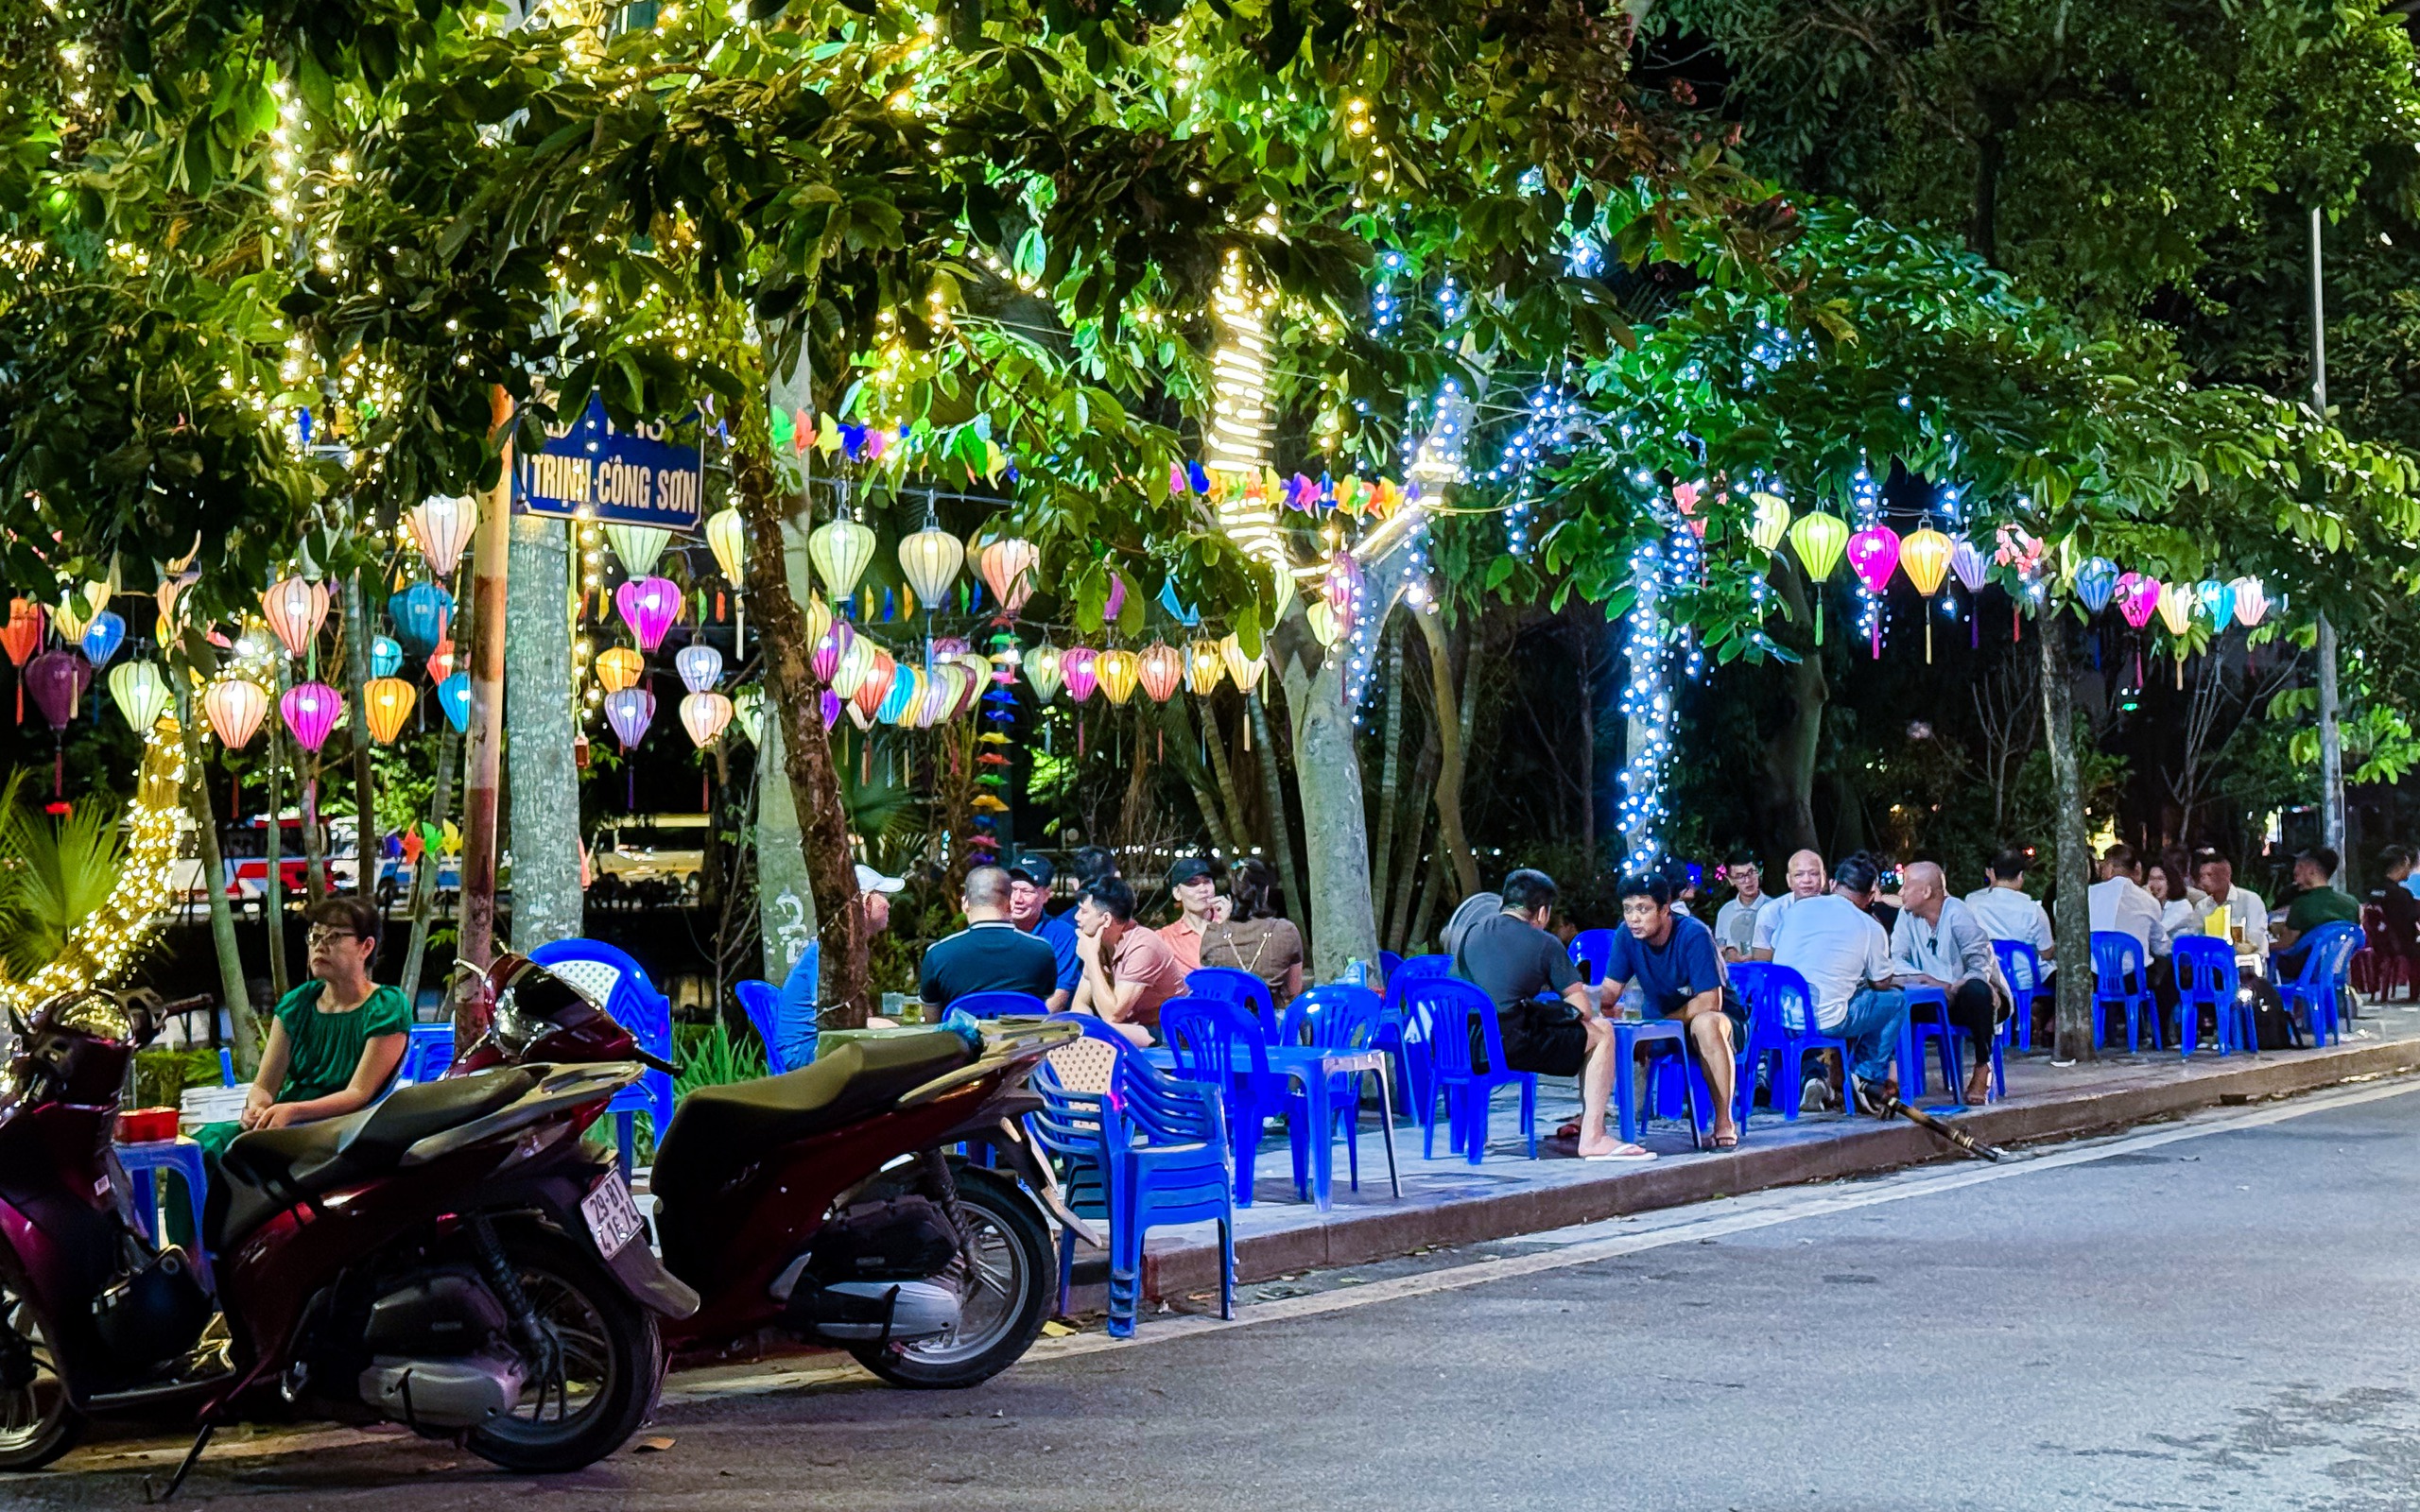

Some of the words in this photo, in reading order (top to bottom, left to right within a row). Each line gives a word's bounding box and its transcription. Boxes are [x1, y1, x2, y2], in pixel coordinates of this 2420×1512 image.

[531, 454, 592, 507] TRỊNH
[597, 455, 651, 508] CÔNG
[656, 469, 697, 513] SƠN
